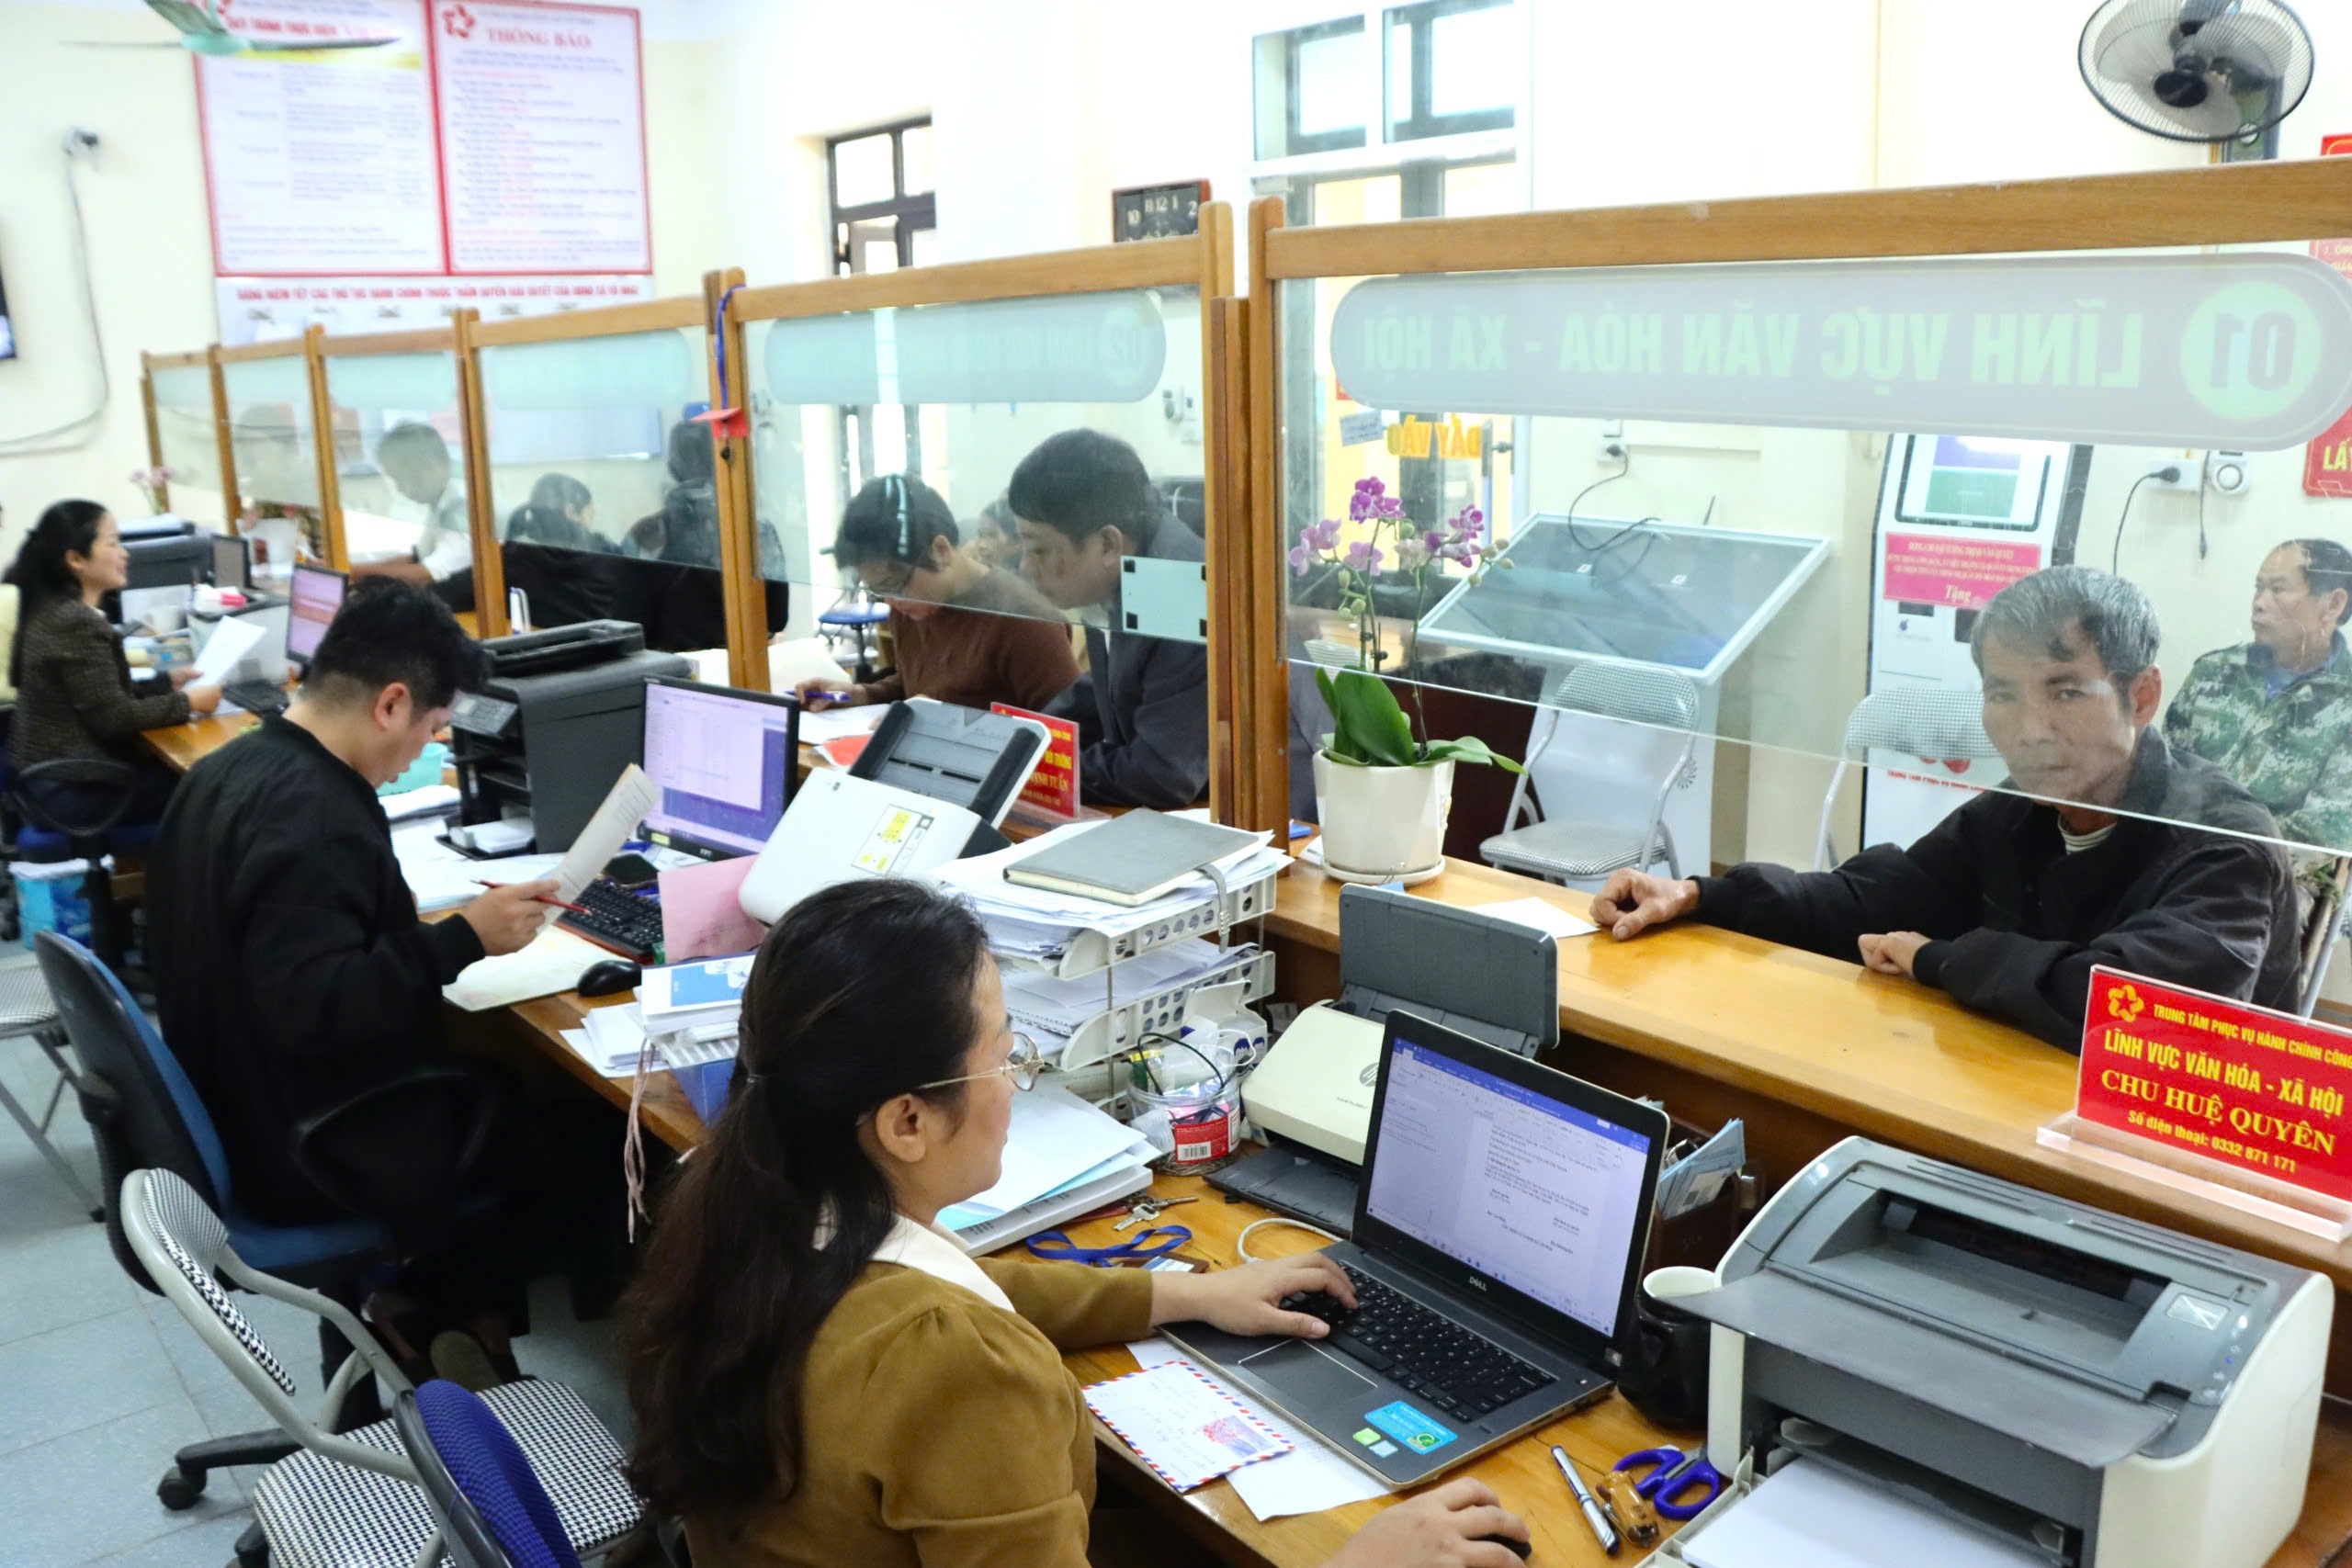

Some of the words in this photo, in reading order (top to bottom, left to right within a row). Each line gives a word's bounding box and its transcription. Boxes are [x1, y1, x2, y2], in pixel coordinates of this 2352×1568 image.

[488, 27, 550, 45] THÔNG
[554, 29, 592, 49] BÁO
[2154, 1004, 2186, 1025] TRUNG
[2188, 1011, 2210, 1032] TÂM
[2211, 1020, 2239, 1040] PHỤC
[2242, 1027, 2256, 1046] VỤ
[2256, 1030, 2287, 1052] HÀNH
[2289, 1039, 2323, 1061] CHÍNH
[2104, 1027, 2143, 1059] LĨNH
[2147, 1041, 2181, 1072] VỰC
[2186, 1050, 2222, 1081] VĂN
[2224, 1062, 2261, 1094] HÓA
[2278, 1077, 2304, 1106] XÃ
[2309, 1086, 2345, 1120] HỘI
[2101, 1068, 2160, 1101] CHU
[2165, 1086, 2223, 1125] HUỆ
[2229, 1106, 2336, 1156] QUYÊN
[2127, 1109, 2146, 1125] Số
[2146, 1115, 2173, 1136] điện
[2175, 1125, 2209, 1147] thoại:
[2211, 1135, 2243, 1157] 0332
[2245, 1145, 2269, 1166] 871
[2272, 1154, 2298, 1174] 171
[1469, 1275, 1487, 1292] DELL
